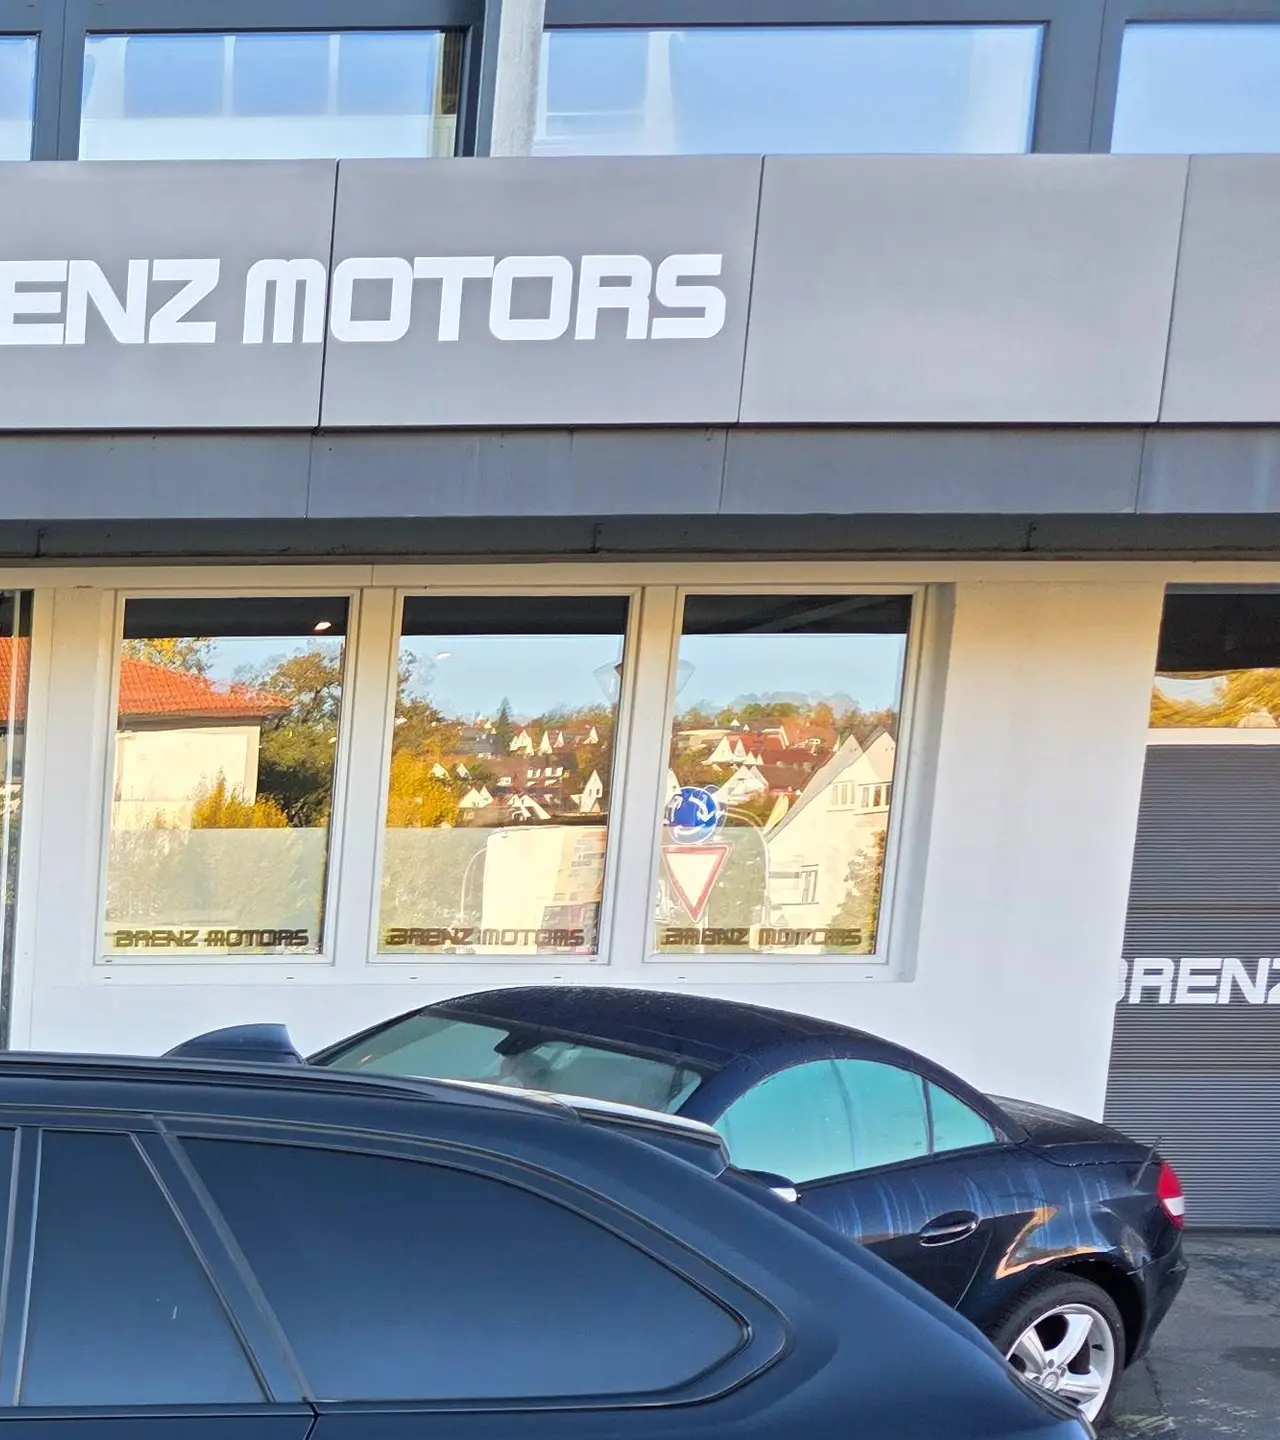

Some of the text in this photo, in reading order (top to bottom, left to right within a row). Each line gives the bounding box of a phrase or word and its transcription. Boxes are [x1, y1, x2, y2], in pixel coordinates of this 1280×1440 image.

[242, 253, 724, 343] MOTORS
[115, 928, 309, 948] BRENZ MOTORS
[386, 927, 584, 946] BRENZ MOTORS
